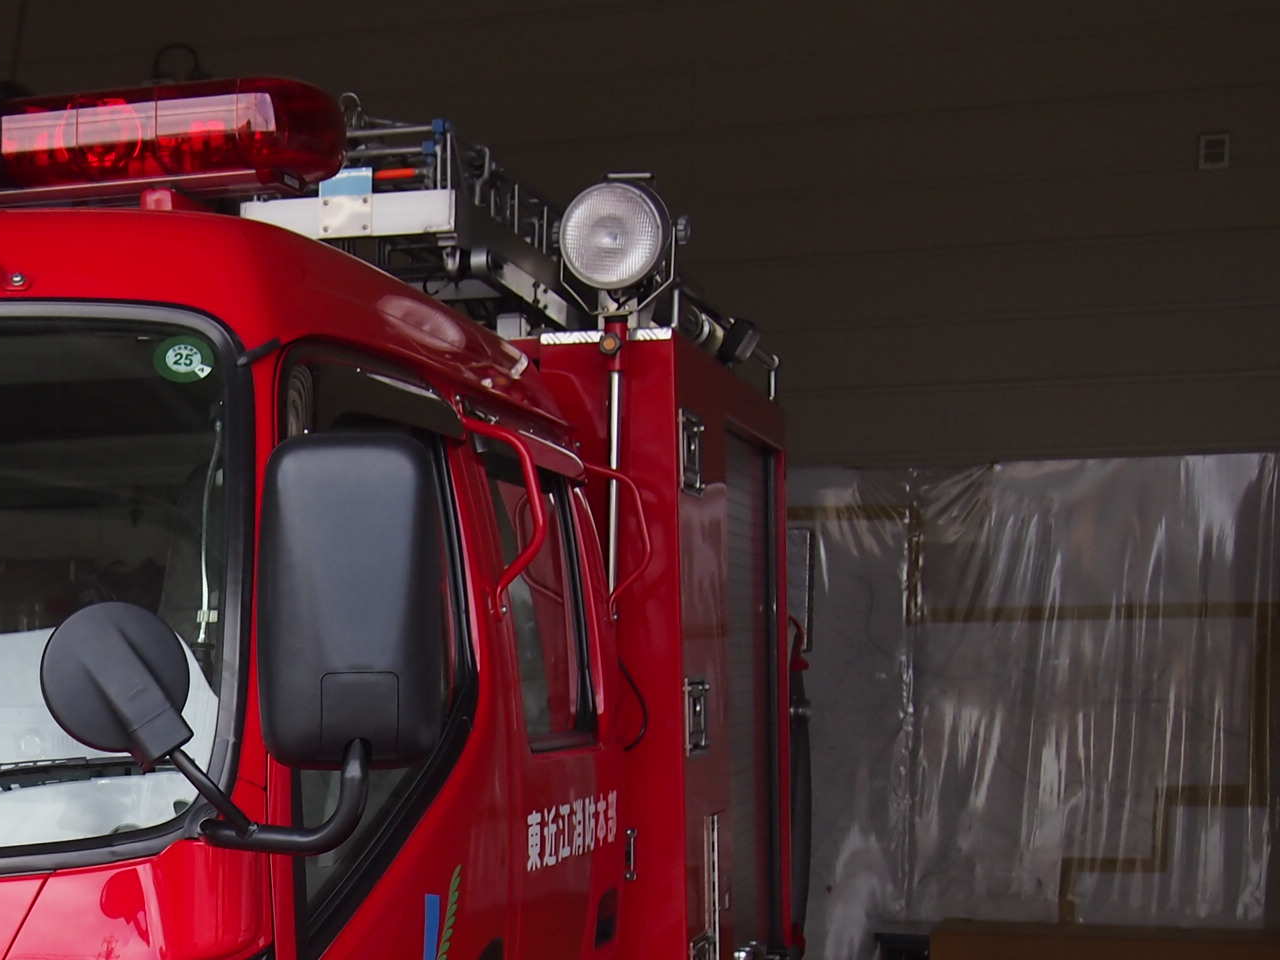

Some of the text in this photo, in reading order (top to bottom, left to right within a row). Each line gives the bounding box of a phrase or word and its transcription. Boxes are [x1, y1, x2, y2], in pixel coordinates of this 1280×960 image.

[173, 352, 194, 367] 25
[527, 789, 617, 872] 東近江消防本部
